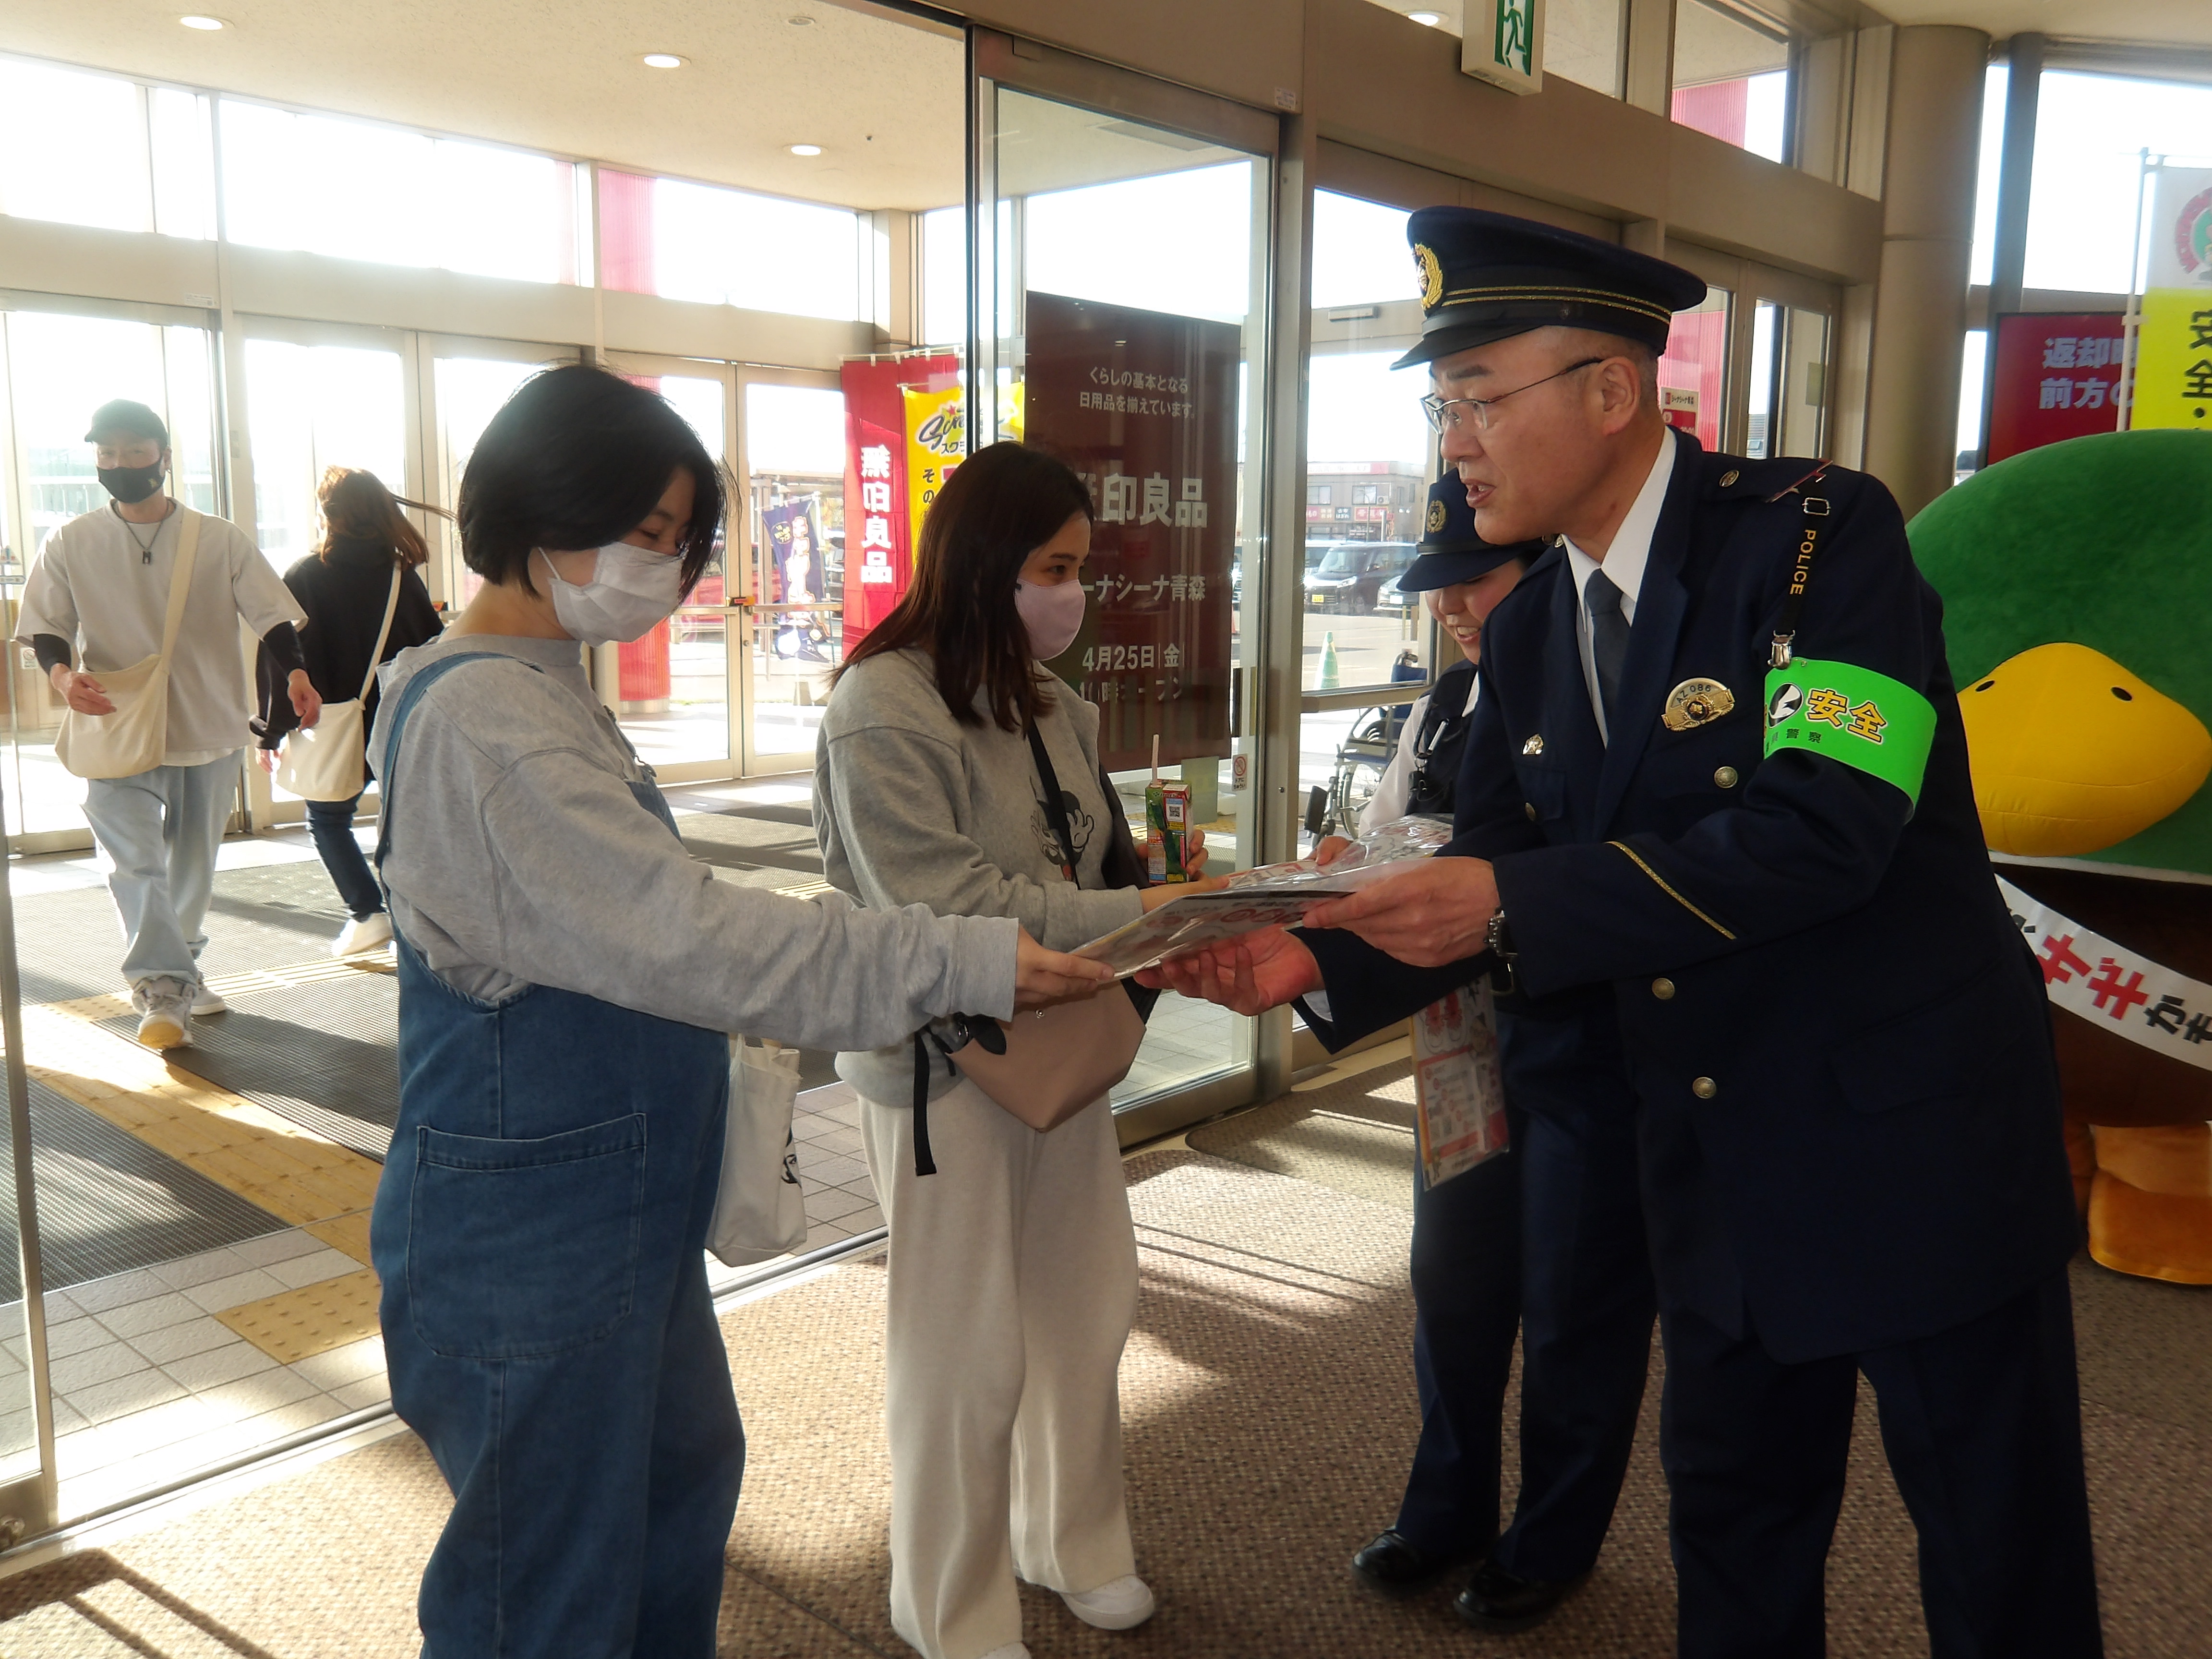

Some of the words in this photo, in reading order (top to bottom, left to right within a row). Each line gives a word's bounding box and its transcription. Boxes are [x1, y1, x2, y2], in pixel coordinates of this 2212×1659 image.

[1089, 366, 1188, 394] くらしの基本となる
[1080, 391, 1195, 419] 日用品を揃えています。
[860, 445, 892, 583] 無印良品
[1790, 529, 1816, 595] POLICE
[1082, 644, 1154, 672] 4月25日
[1690, 684, 1711, 692] 086
[1806, 688, 1887, 744] 安全
